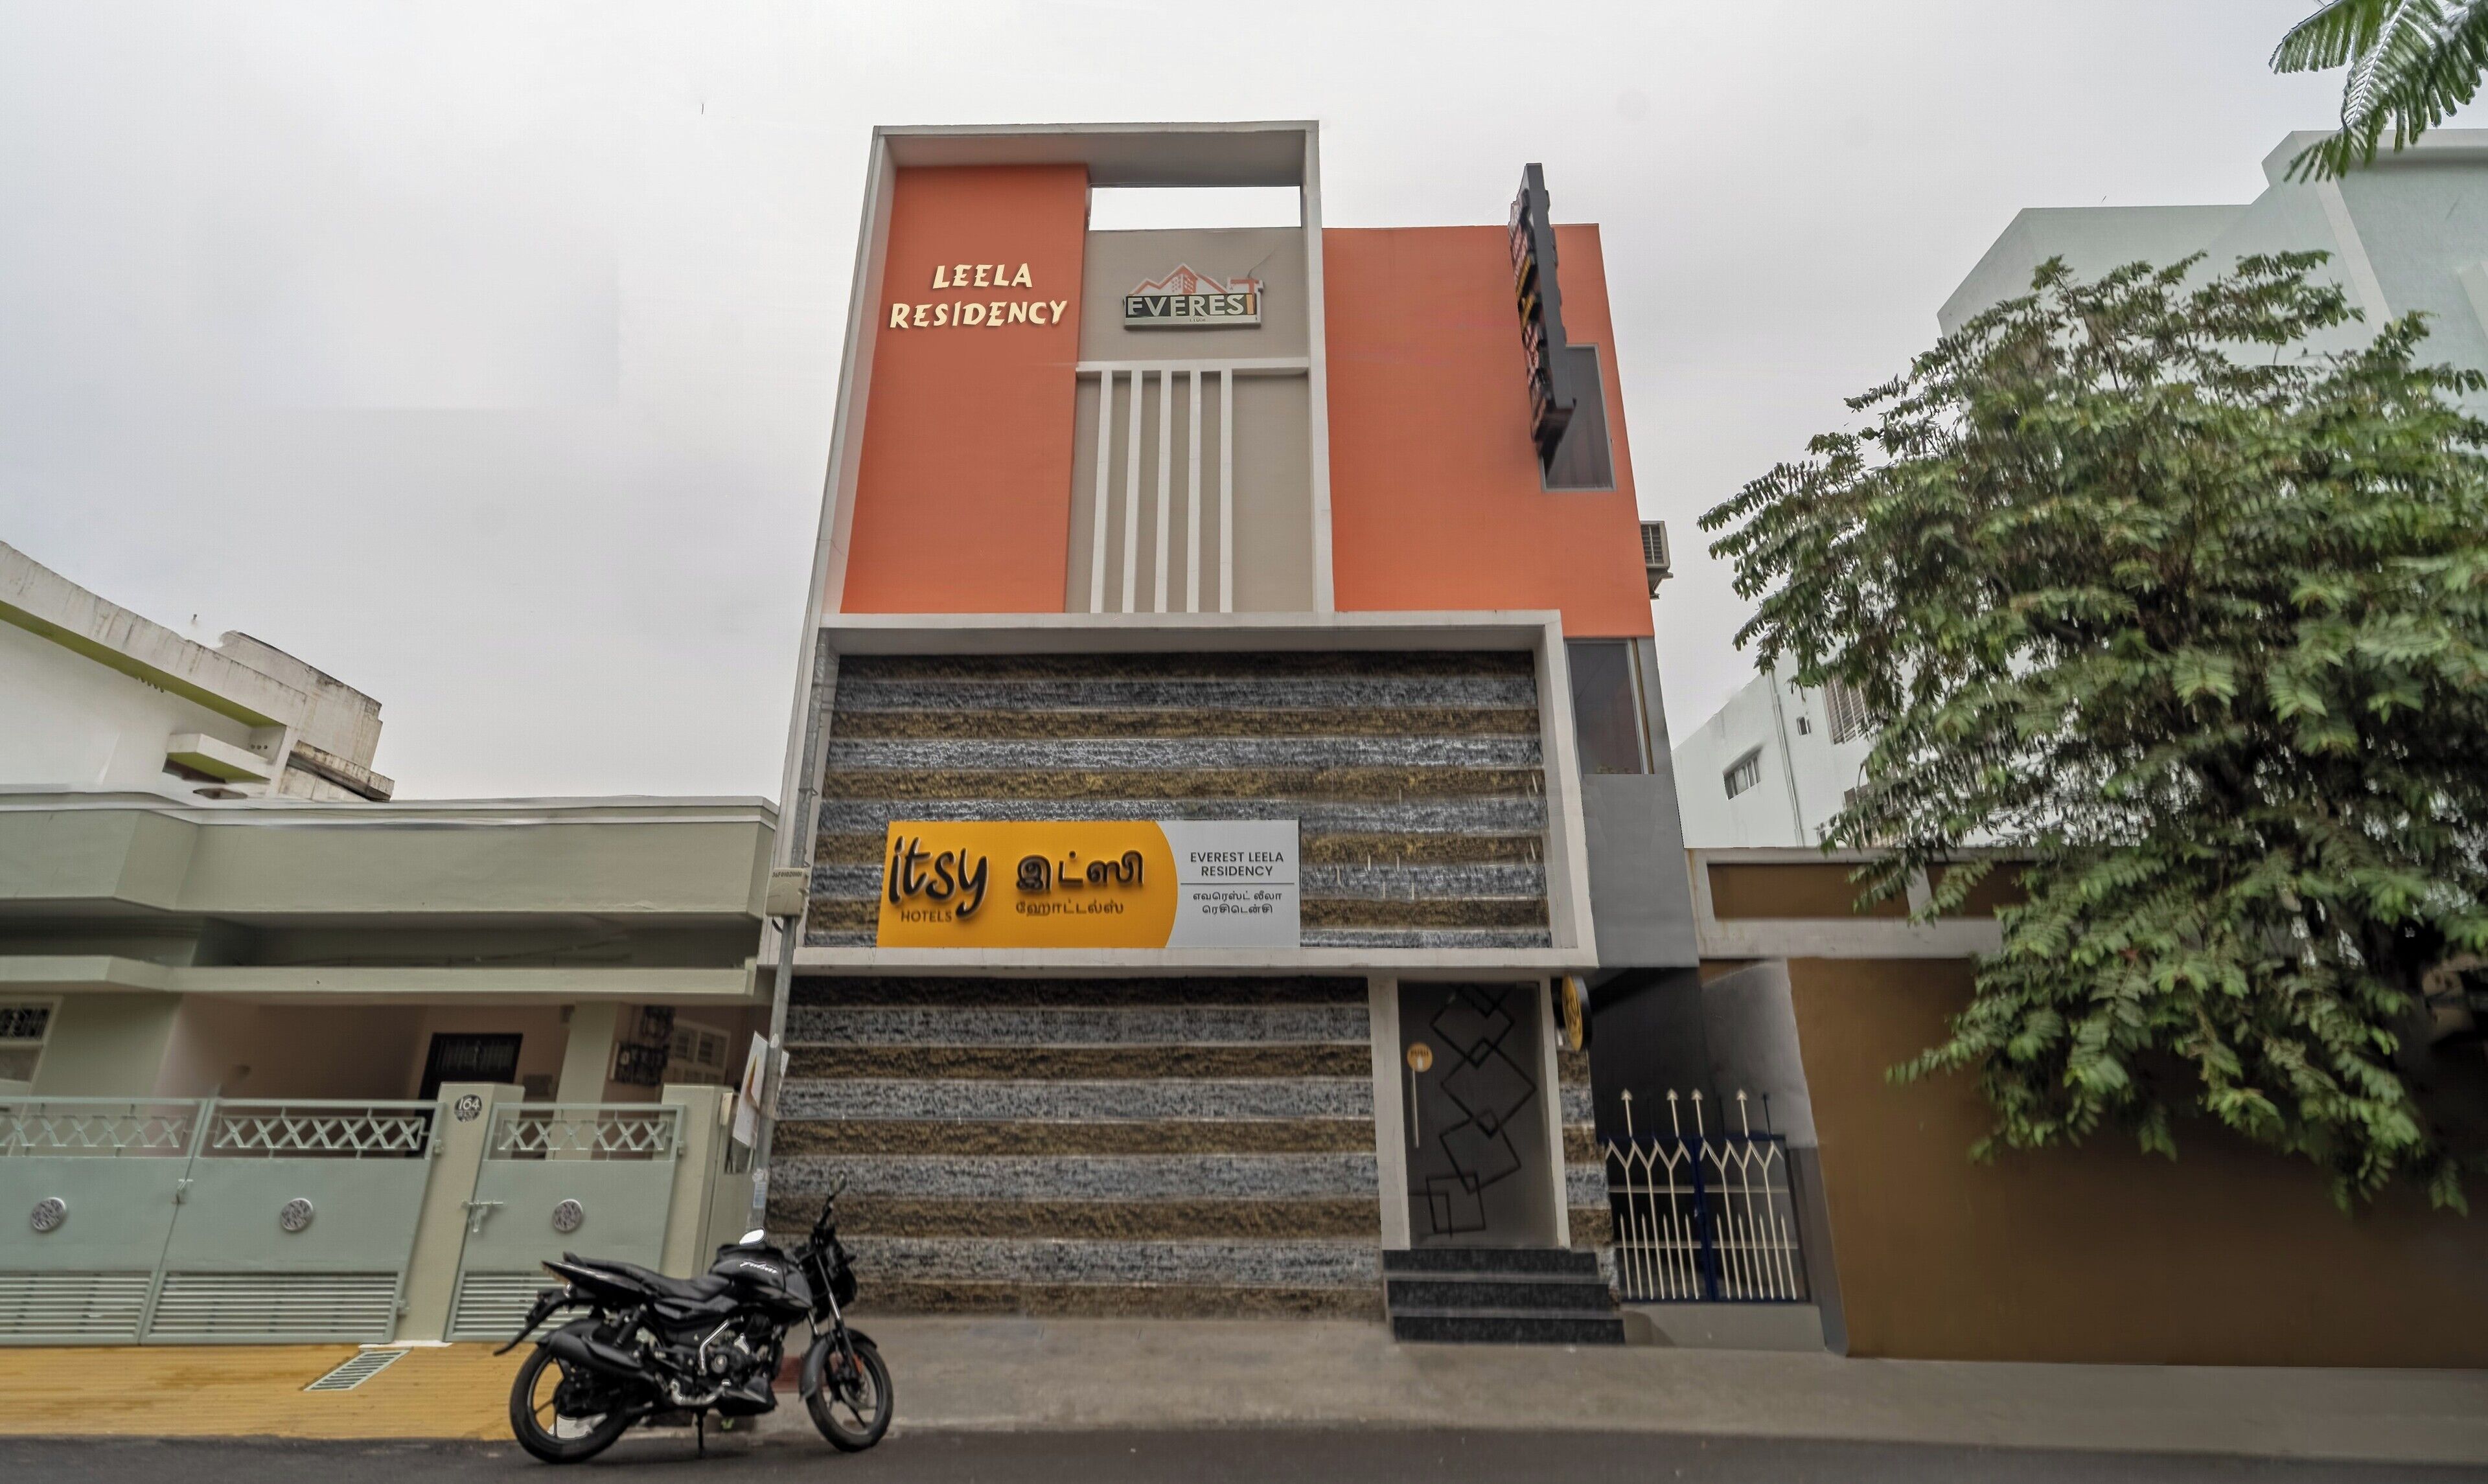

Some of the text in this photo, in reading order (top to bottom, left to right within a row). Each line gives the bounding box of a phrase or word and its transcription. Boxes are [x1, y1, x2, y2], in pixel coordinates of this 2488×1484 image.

[932, 262, 1033, 289] LEELA
[890, 300, 1068, 328] RESIDENCY
[1190, 852, 1284, 863] EVEREST LEELA
[888, 835, 989, 919] itsy
[1016, 849, 1144, 893] இட்ஸி
[1201, 865, 1273, 876] RESIDENCY
[1193, 890, 1282, 902] எவரெஸ்ட் லீலா
[1202, 903, 1273, 915] ரெசிடென்சி
[901, 909, 952, 923] HOTELS
[459, 1097, 480, 1110] 164
